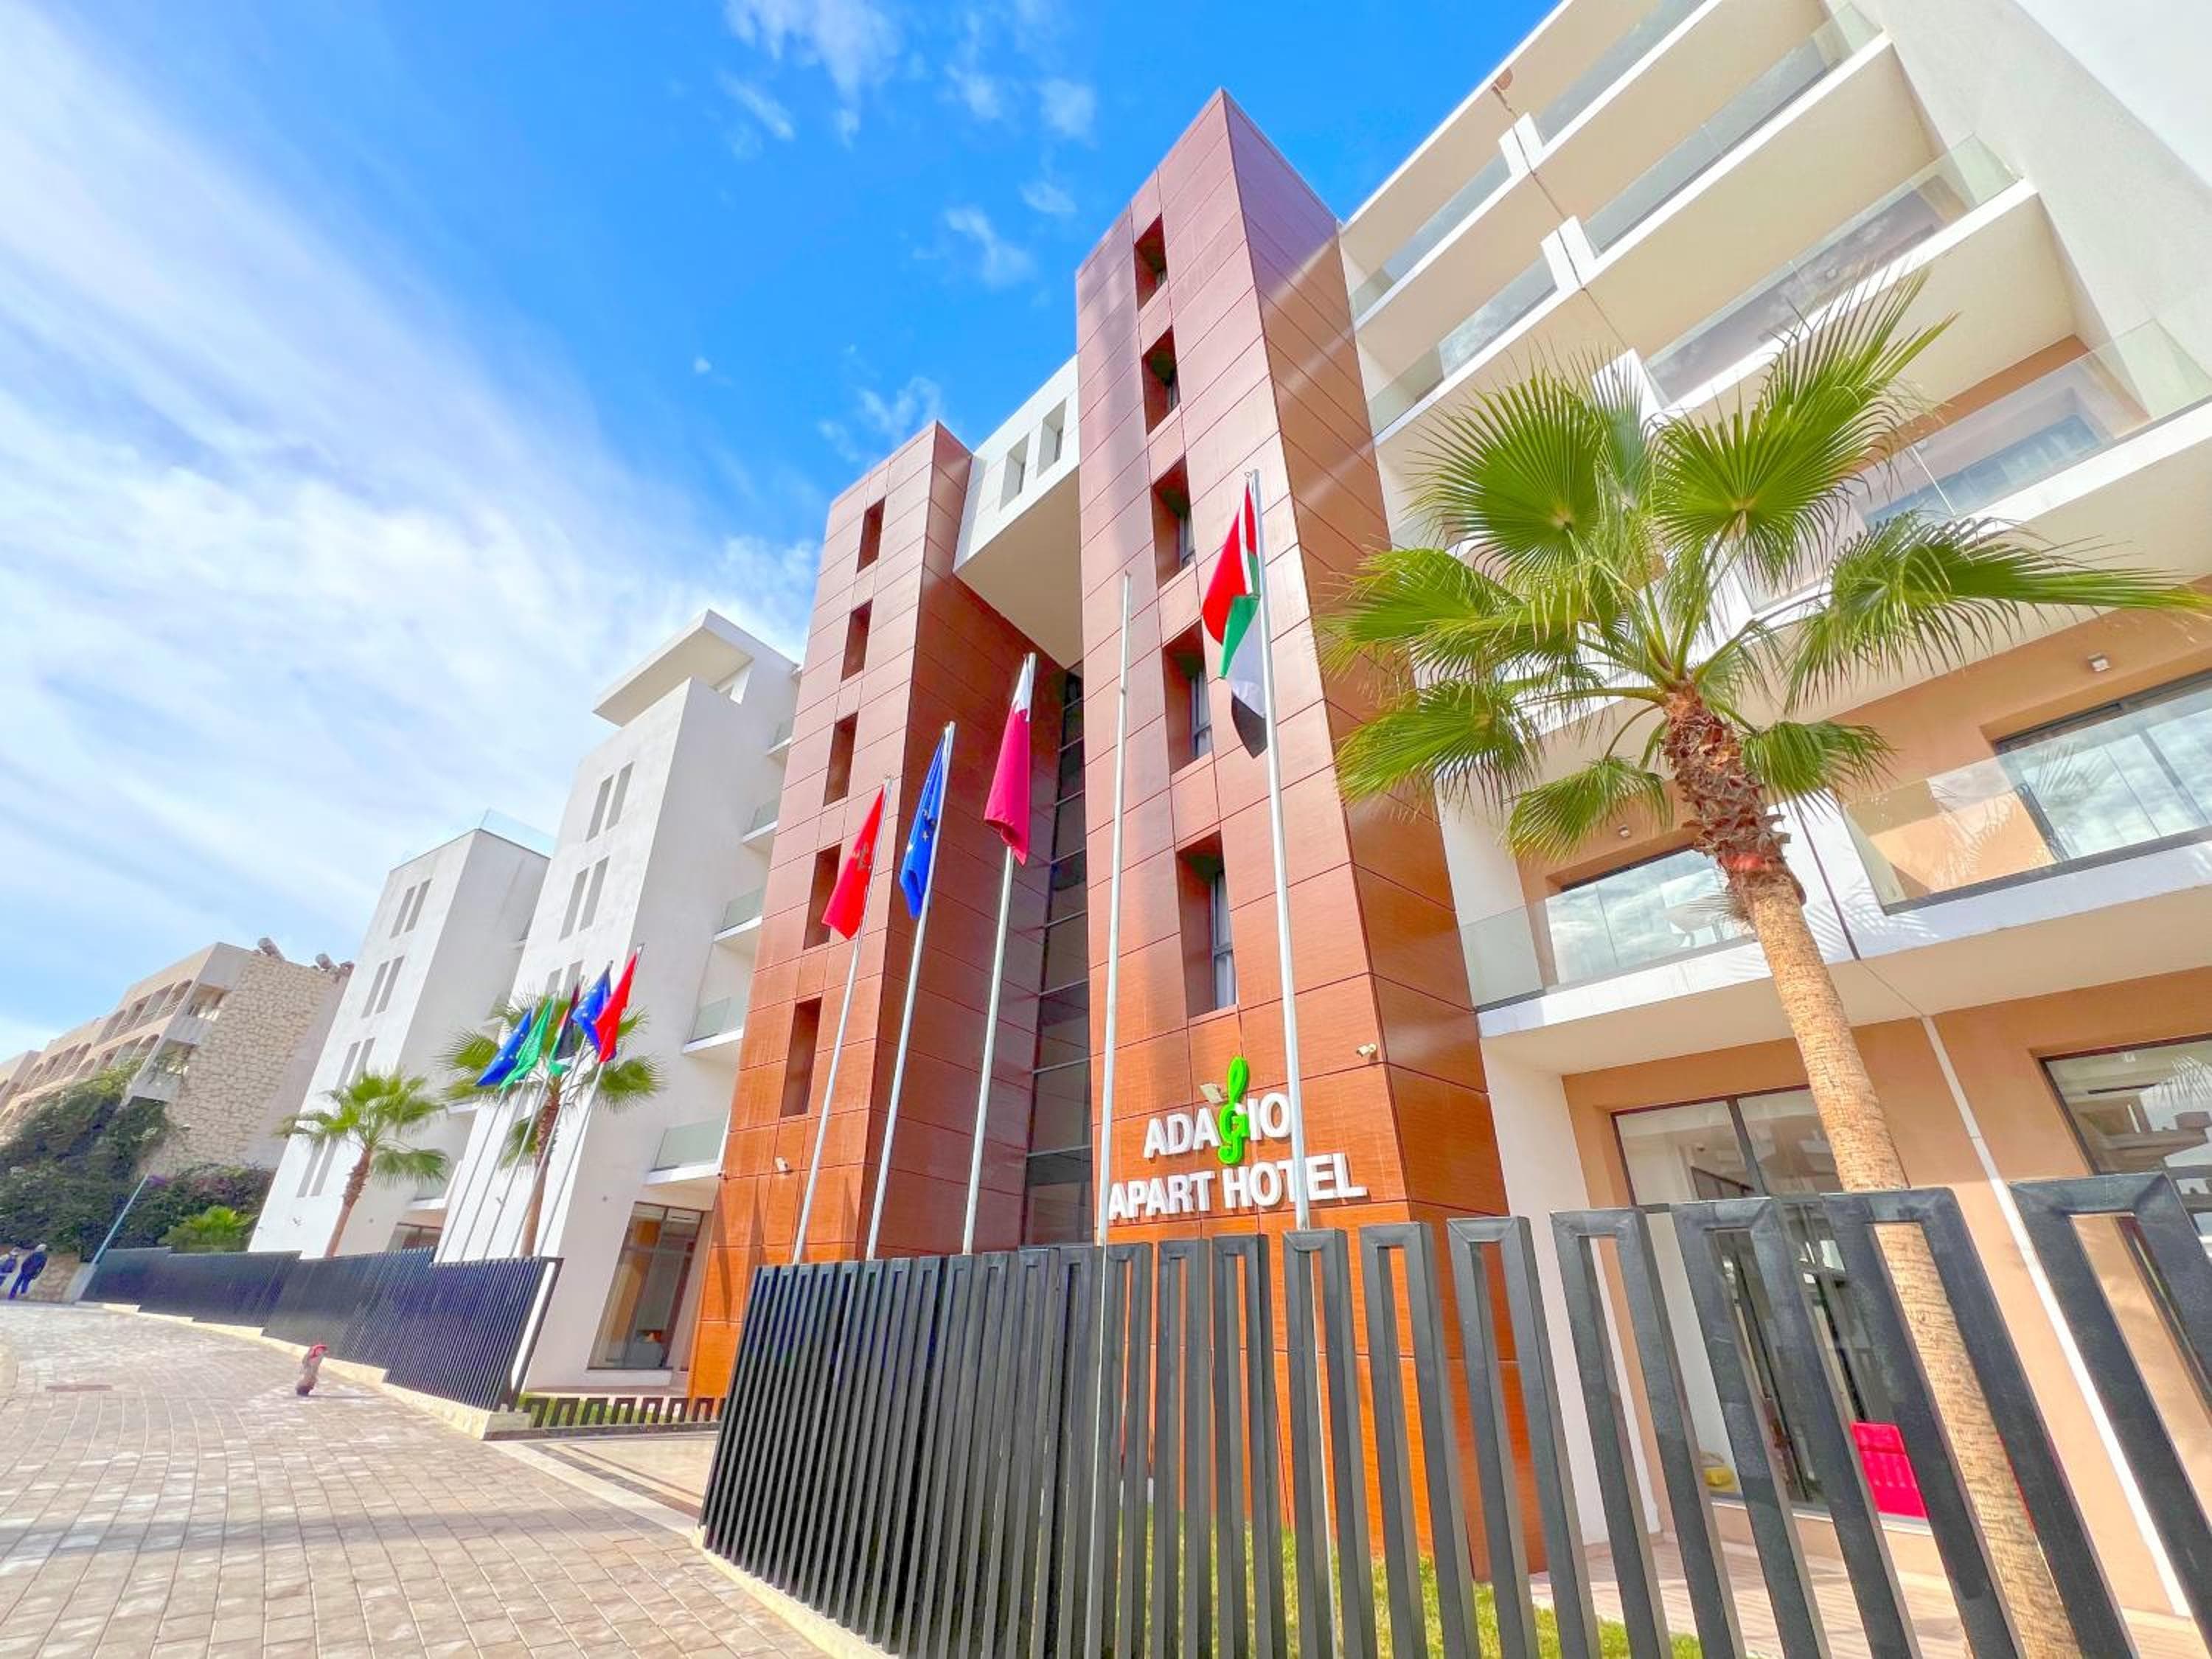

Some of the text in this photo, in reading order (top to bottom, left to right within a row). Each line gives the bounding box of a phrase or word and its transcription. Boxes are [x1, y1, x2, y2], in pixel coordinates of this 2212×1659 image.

[1144, 1055, 1292, 1165] ADAGIO
[1108, 1152, 1368, 1220] APART HOTEL
